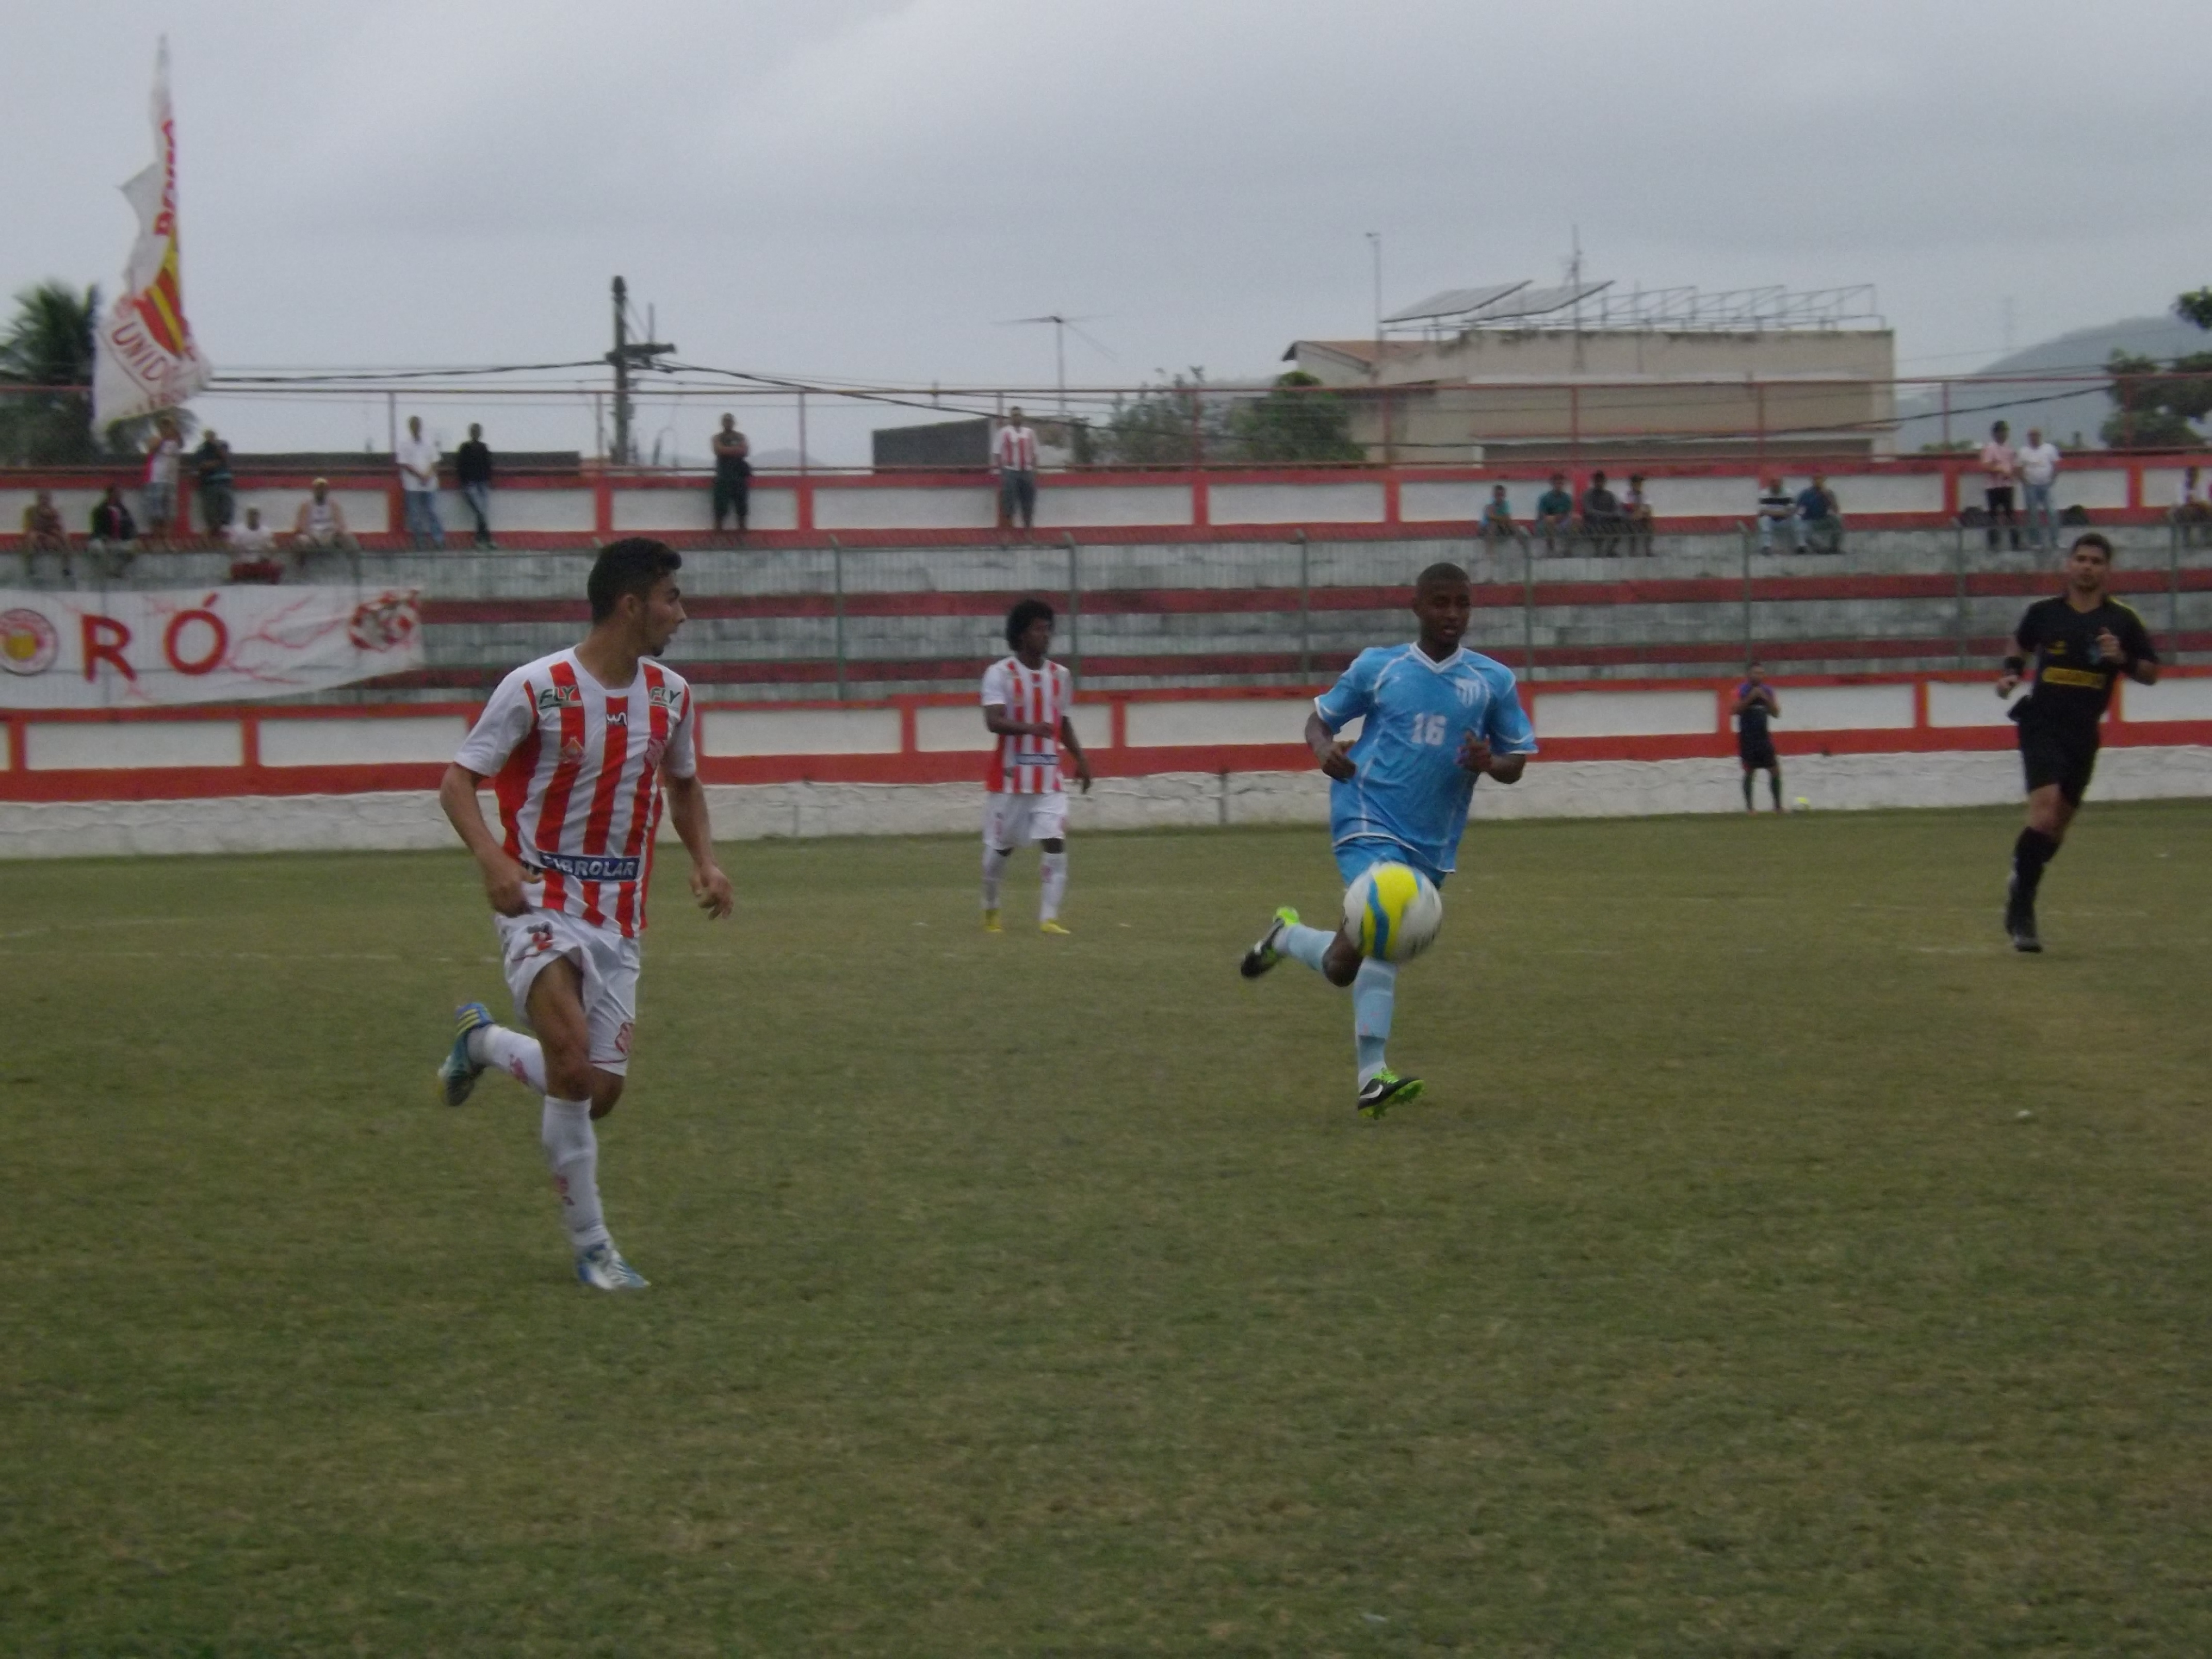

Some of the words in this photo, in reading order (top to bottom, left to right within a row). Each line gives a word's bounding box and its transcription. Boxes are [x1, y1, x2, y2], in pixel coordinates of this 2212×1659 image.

[539, 686, 576, 703] FLY
[650, 687, 681, 703] FLY
[1411, 712, 1446, 745] 16
